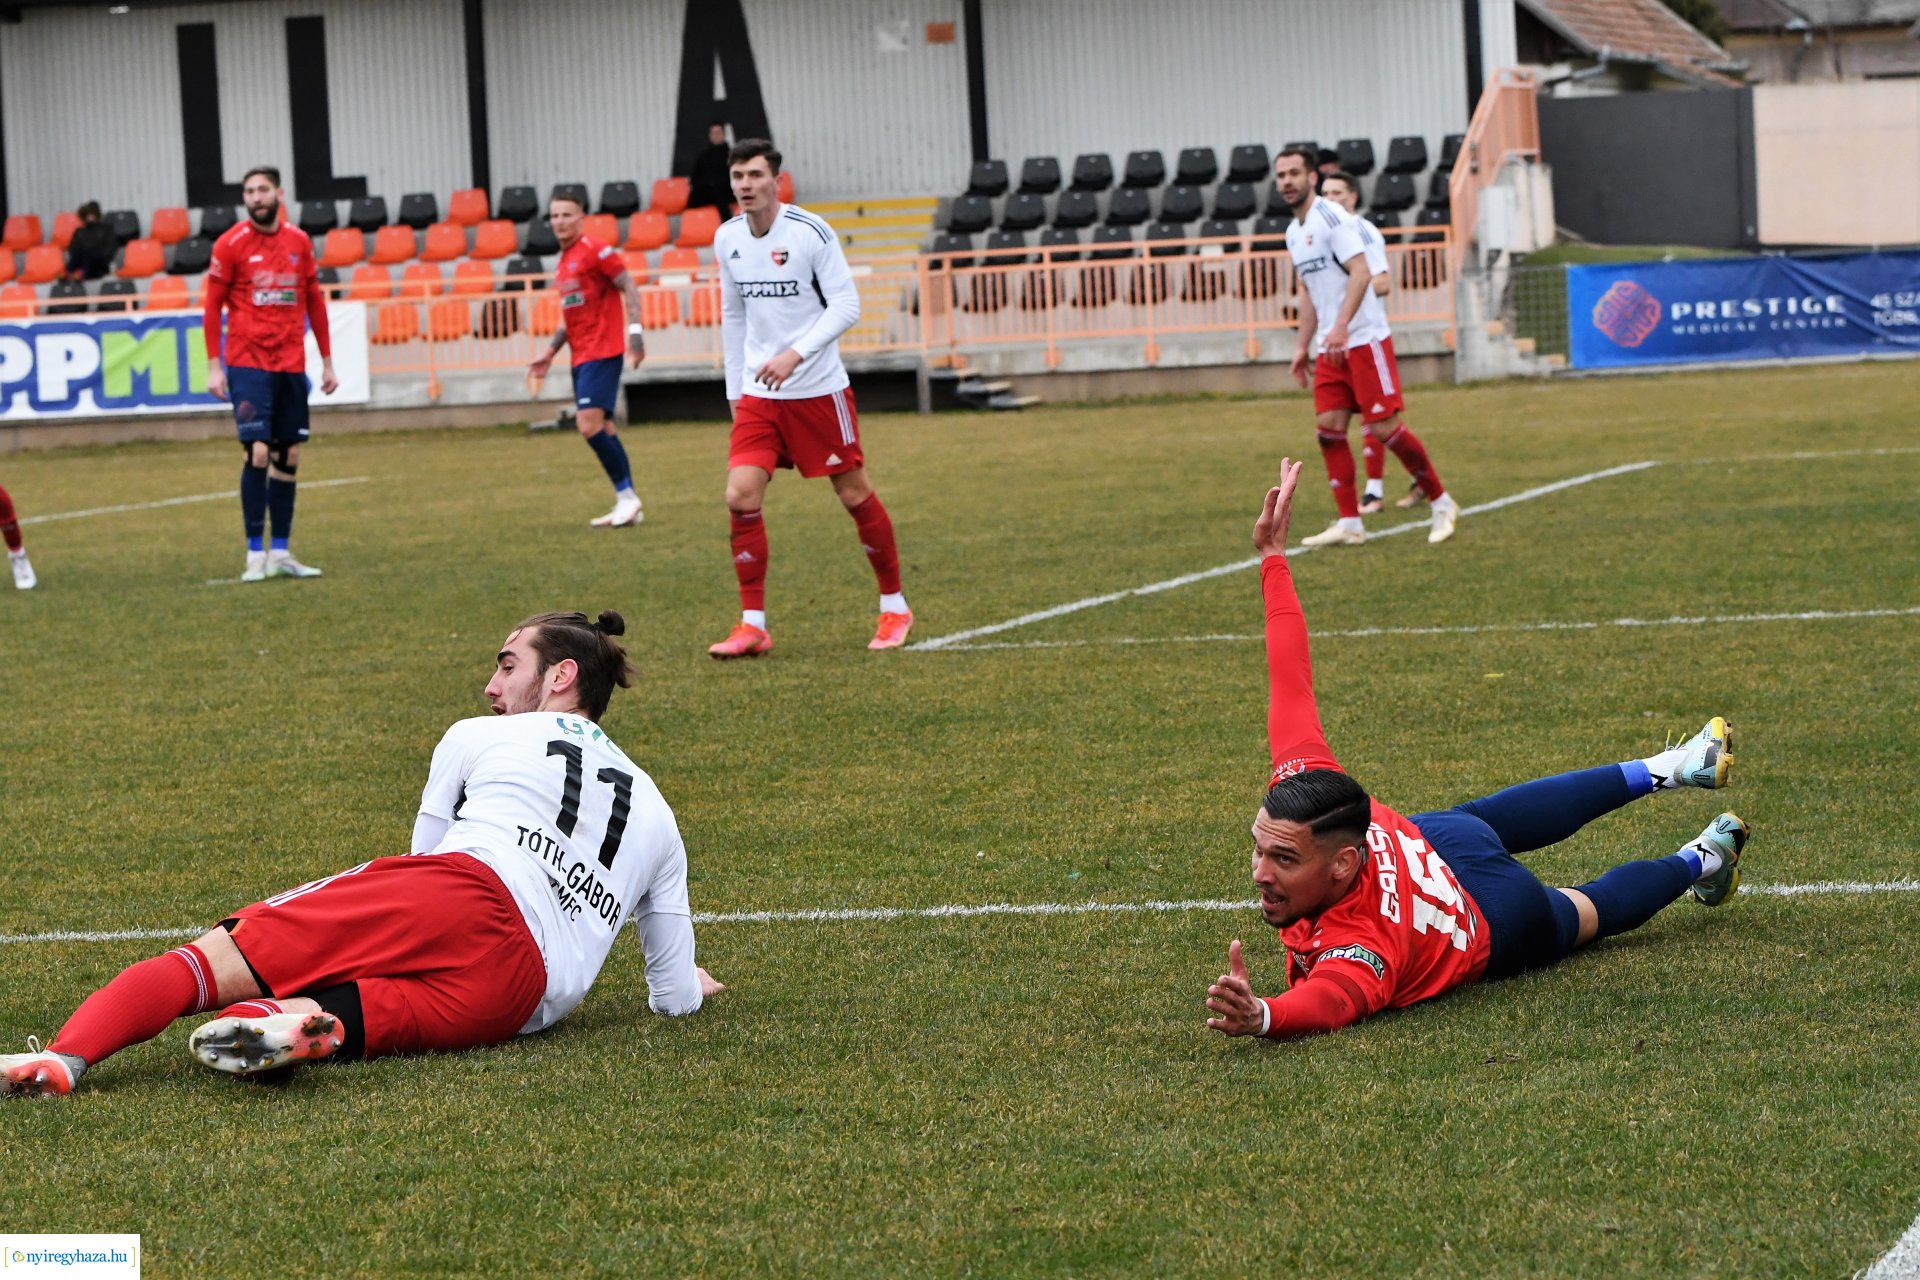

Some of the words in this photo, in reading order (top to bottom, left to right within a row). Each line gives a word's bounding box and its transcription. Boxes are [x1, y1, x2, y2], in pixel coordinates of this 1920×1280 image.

[1671, 296, 1842, 321] PRESTIGE
[1672, 321, 1756, 335] MEDICAL
[1770, 318, 1848, 331] CENTER
[546, 739, 634, 871] 11
[516, 825, 622, 932] TÓTH-GÁBOR
